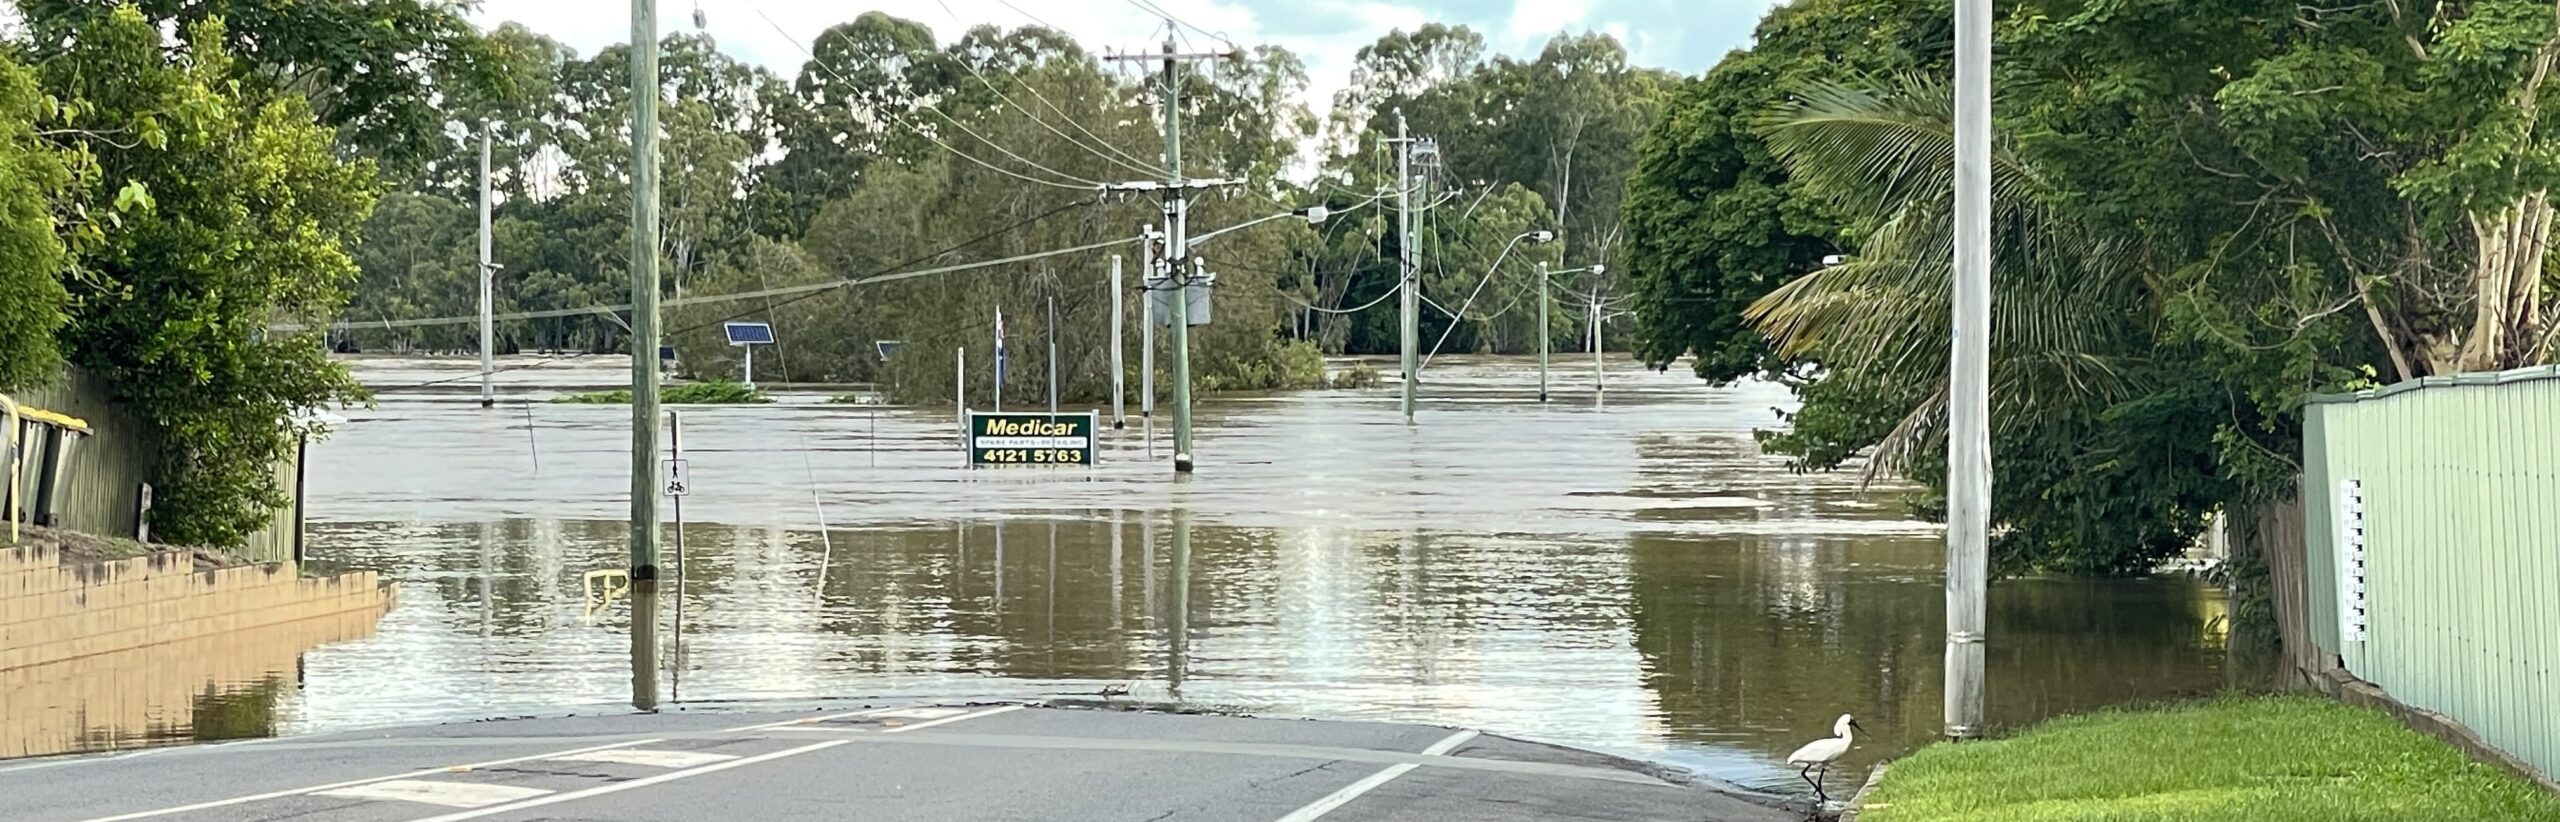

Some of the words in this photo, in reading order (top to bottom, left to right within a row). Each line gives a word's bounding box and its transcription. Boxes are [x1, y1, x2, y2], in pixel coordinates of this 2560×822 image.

[986, 419, 1077, 435] Medicar
[984, 449, 1027, 462] 4121
[1033, 449, 1082, 462] 5763
